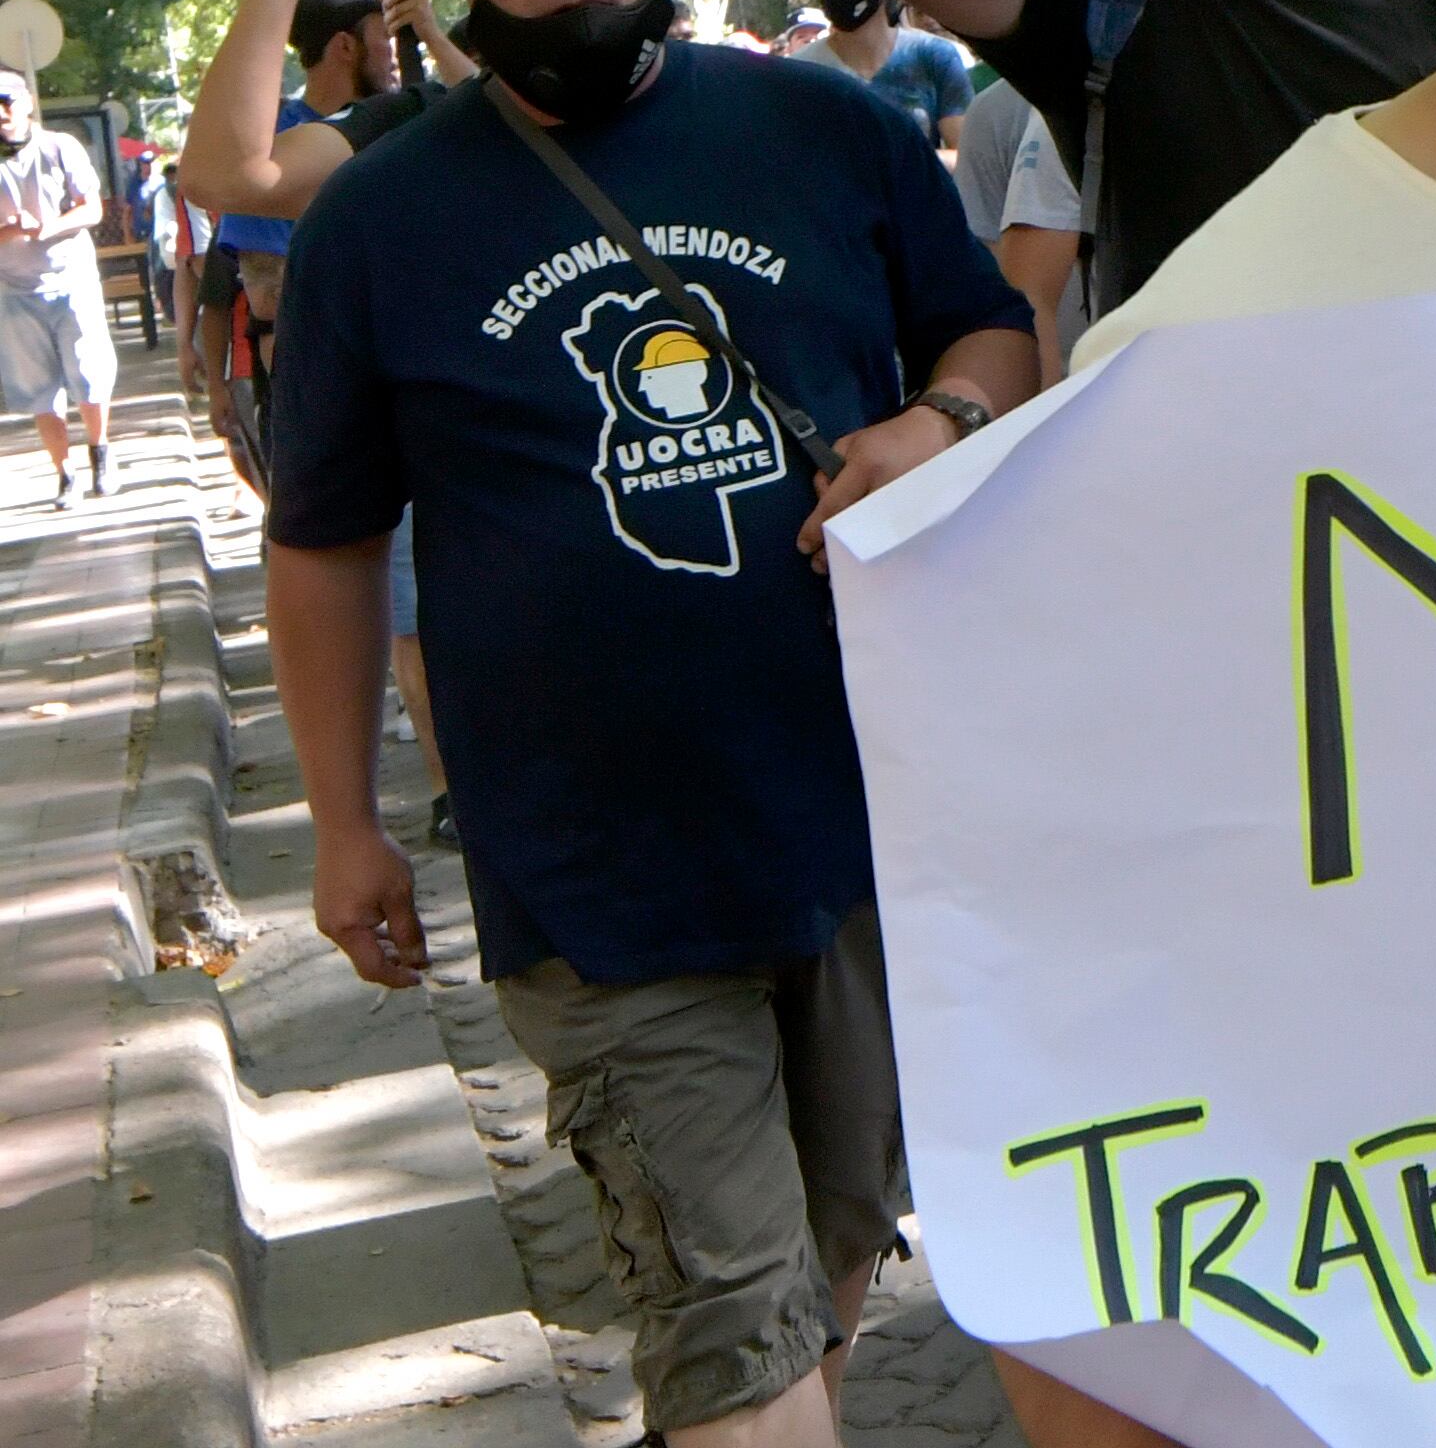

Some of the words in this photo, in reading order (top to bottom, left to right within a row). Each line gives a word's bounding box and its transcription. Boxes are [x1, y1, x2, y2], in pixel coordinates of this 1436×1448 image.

[642, 225, 787, 285] MENDOZA
[615, 418, 764, 471] UOCRA
[621, 449, 773, 495] PRESENTE
